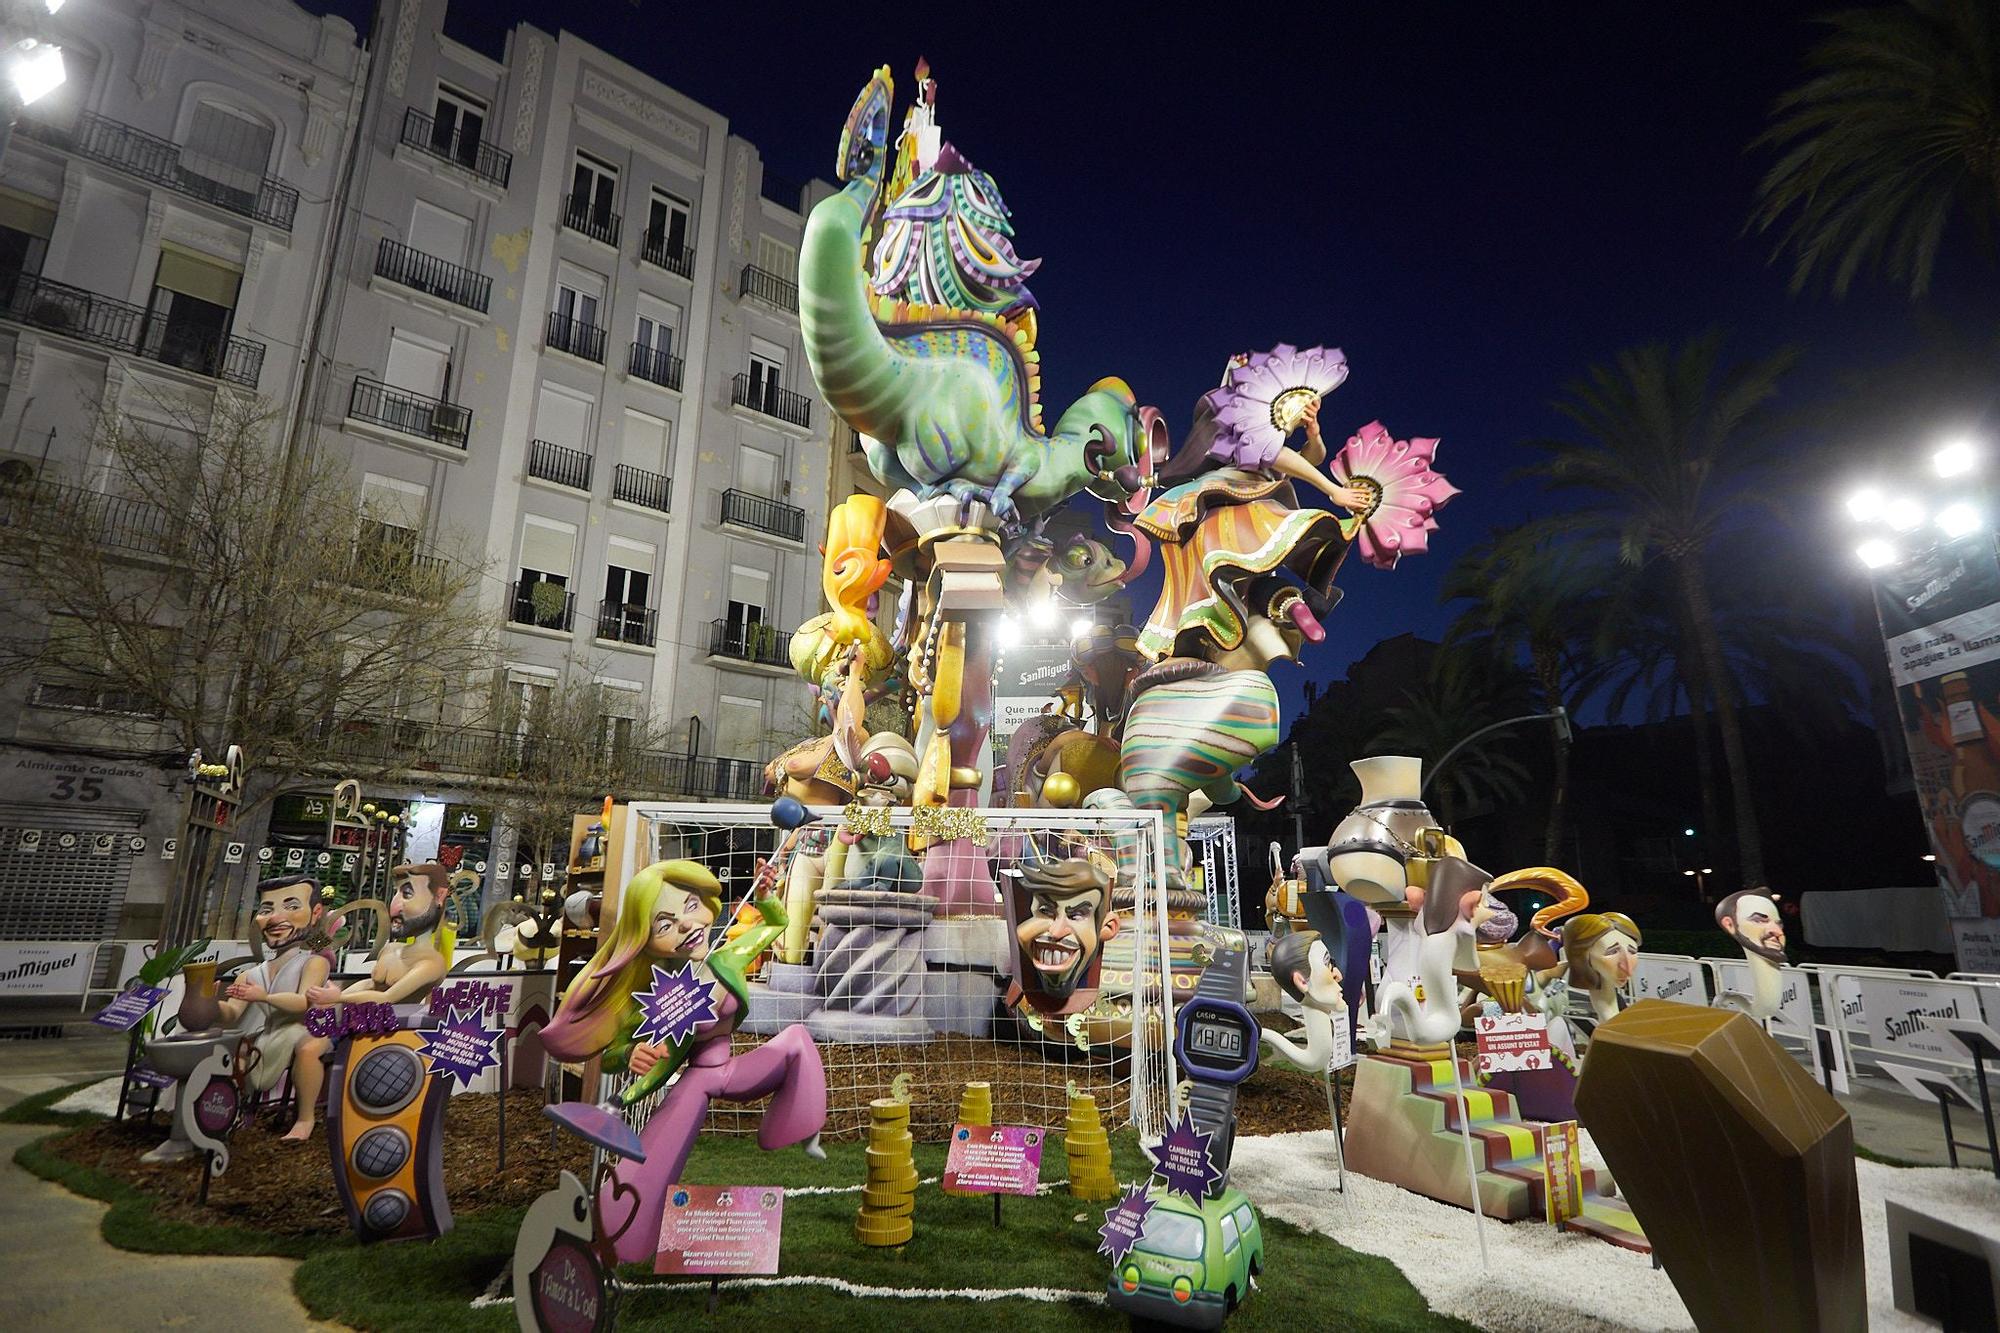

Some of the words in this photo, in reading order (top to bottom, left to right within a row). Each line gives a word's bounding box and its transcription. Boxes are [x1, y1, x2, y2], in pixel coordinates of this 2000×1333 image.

[1900, 643, 1922, 658] Que
[1925, 632, 1955, 648] nada
[1903, 650, 1944, 671] apague
[1948, 646, 1960, 656] la
[1019, 660, 1070, 685] SanMiguel
[1005, 706, 1025, 715] Que
[1028, 706, 1041, 714] na
[16, 760, 86, 773] Almirante
[90, 766, 144, 778] Cadarso
[50, 775, 104, 802] 35
[0, 953, 76, 982] anMiguel
[1657, 972, 1692, 1000] SanMiguel
[429, 980, 513, 1016] MENTE
[1196, 1011, 1216, 1020] CASIO
[442, 1028, 452, 1036] YO
[1486, 1034, 1514, 1042] FECUNDAR
[1498, 1042, 1517, 1050] ASSUNT
[460, 1050, 474, 1059] QUE
[475, 1054, 484, 1062] TE
[1168, 1145, 1201, 1158] CAMBIASTE
[1165, 1161, 1176, 1170] POR
[1176, 1165, 1186, 1173] UN
[1186, 1166, 1204, 1177] CASIO
[1170, 1154, 1179, 1162] UN
[1180, 1156, 1199, 1167] ROLEX
[564, 1259, 576, 1285] De
